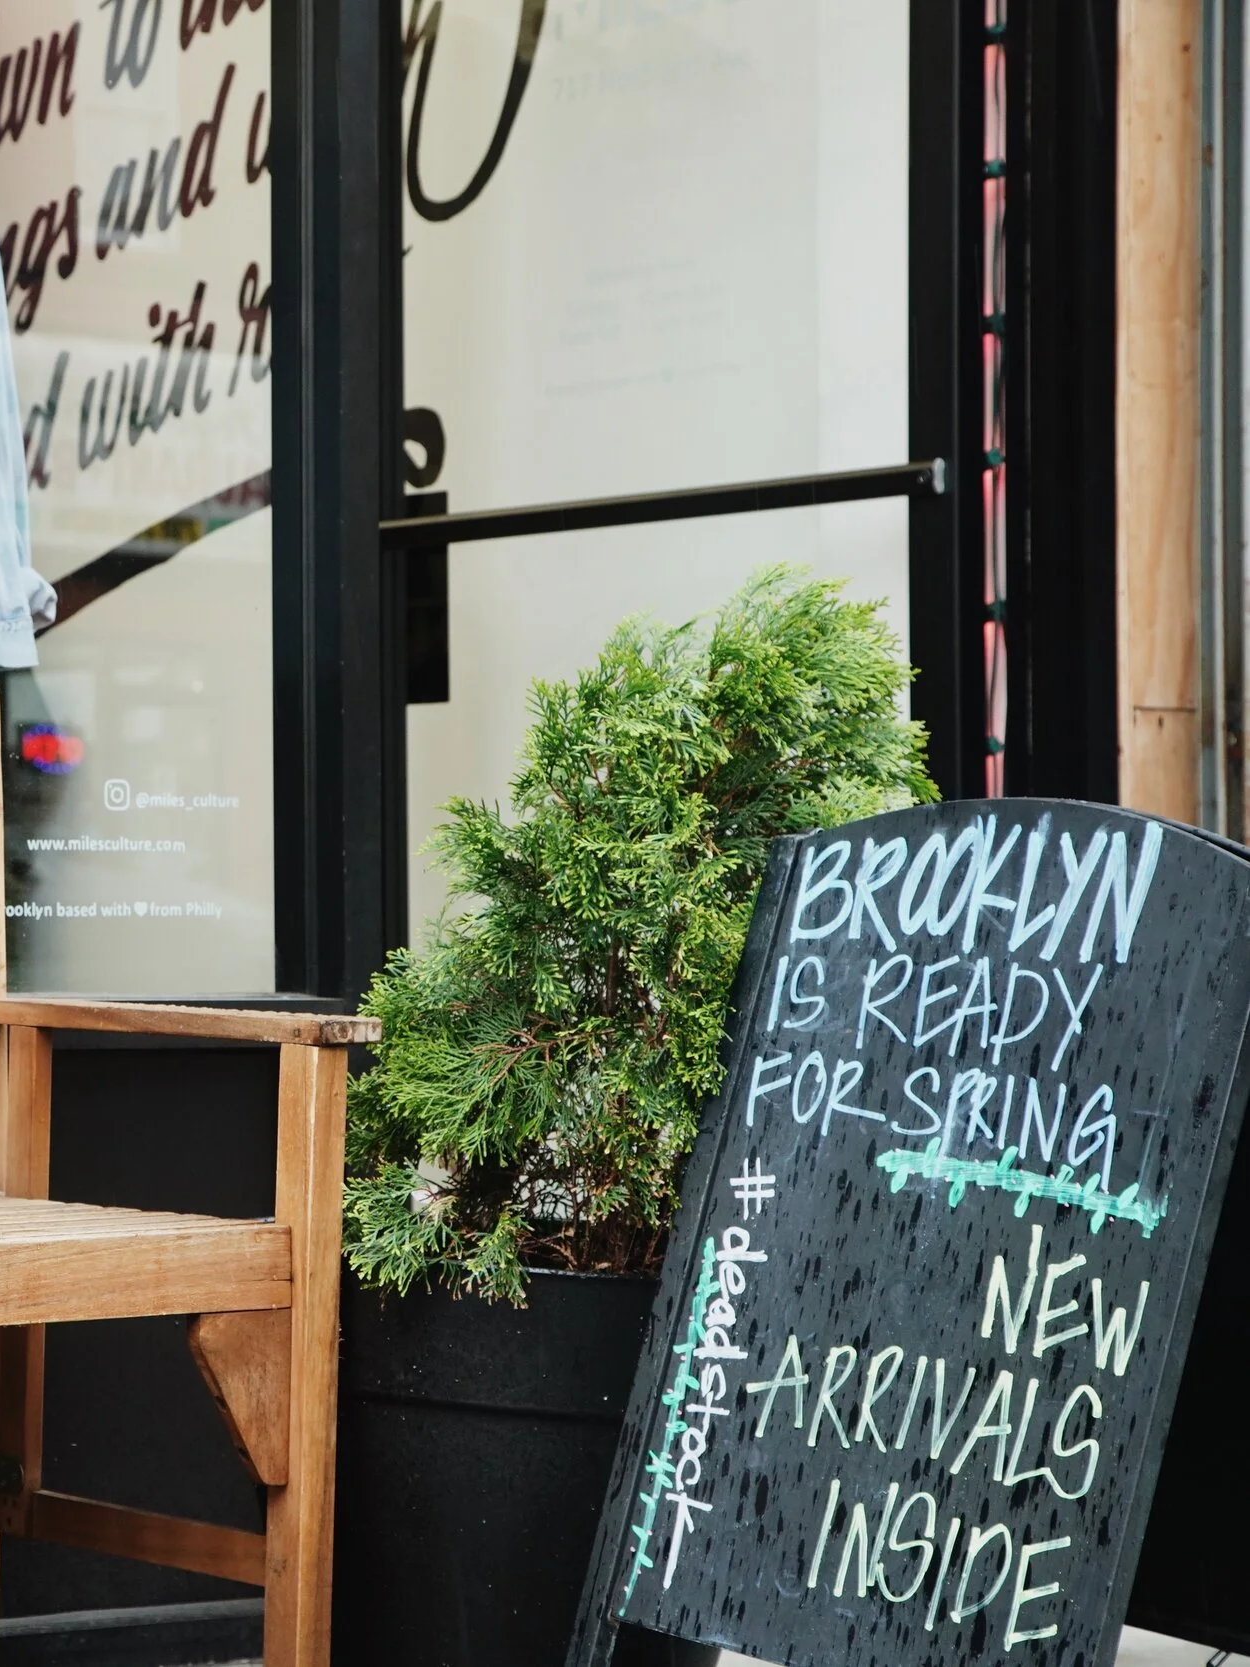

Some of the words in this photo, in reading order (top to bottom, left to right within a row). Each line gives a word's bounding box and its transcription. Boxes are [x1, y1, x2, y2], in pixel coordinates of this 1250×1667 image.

[96, 62, 236, 261] and
[78, 279, 216, 471] with
[27, 836, 186, 853] www.milesculture.com
[135, 791, 240, 811] @miles_culture
[4, 901, 53, 920] ooklyn
[56, 901, 97, 918] based
[101, 901, 132, 917] with
[150, 901, 182, 917] from
[185, 900, 223, 920] Philly
[790, 813, 1163, 963] BROOKLYN
[766, 954, 825, 1032] IS
[854, 953, 1104, 1072] READY
[746, 1050, 887, 1137] FOR
[890, 1065, 1117, 1193] SPRING
[981, 1224, 1149, 1377] NEW
[746, 1334, 1103, 1499] ARRIVALS
[808, 1478, 1071, 1652] INSIDE
